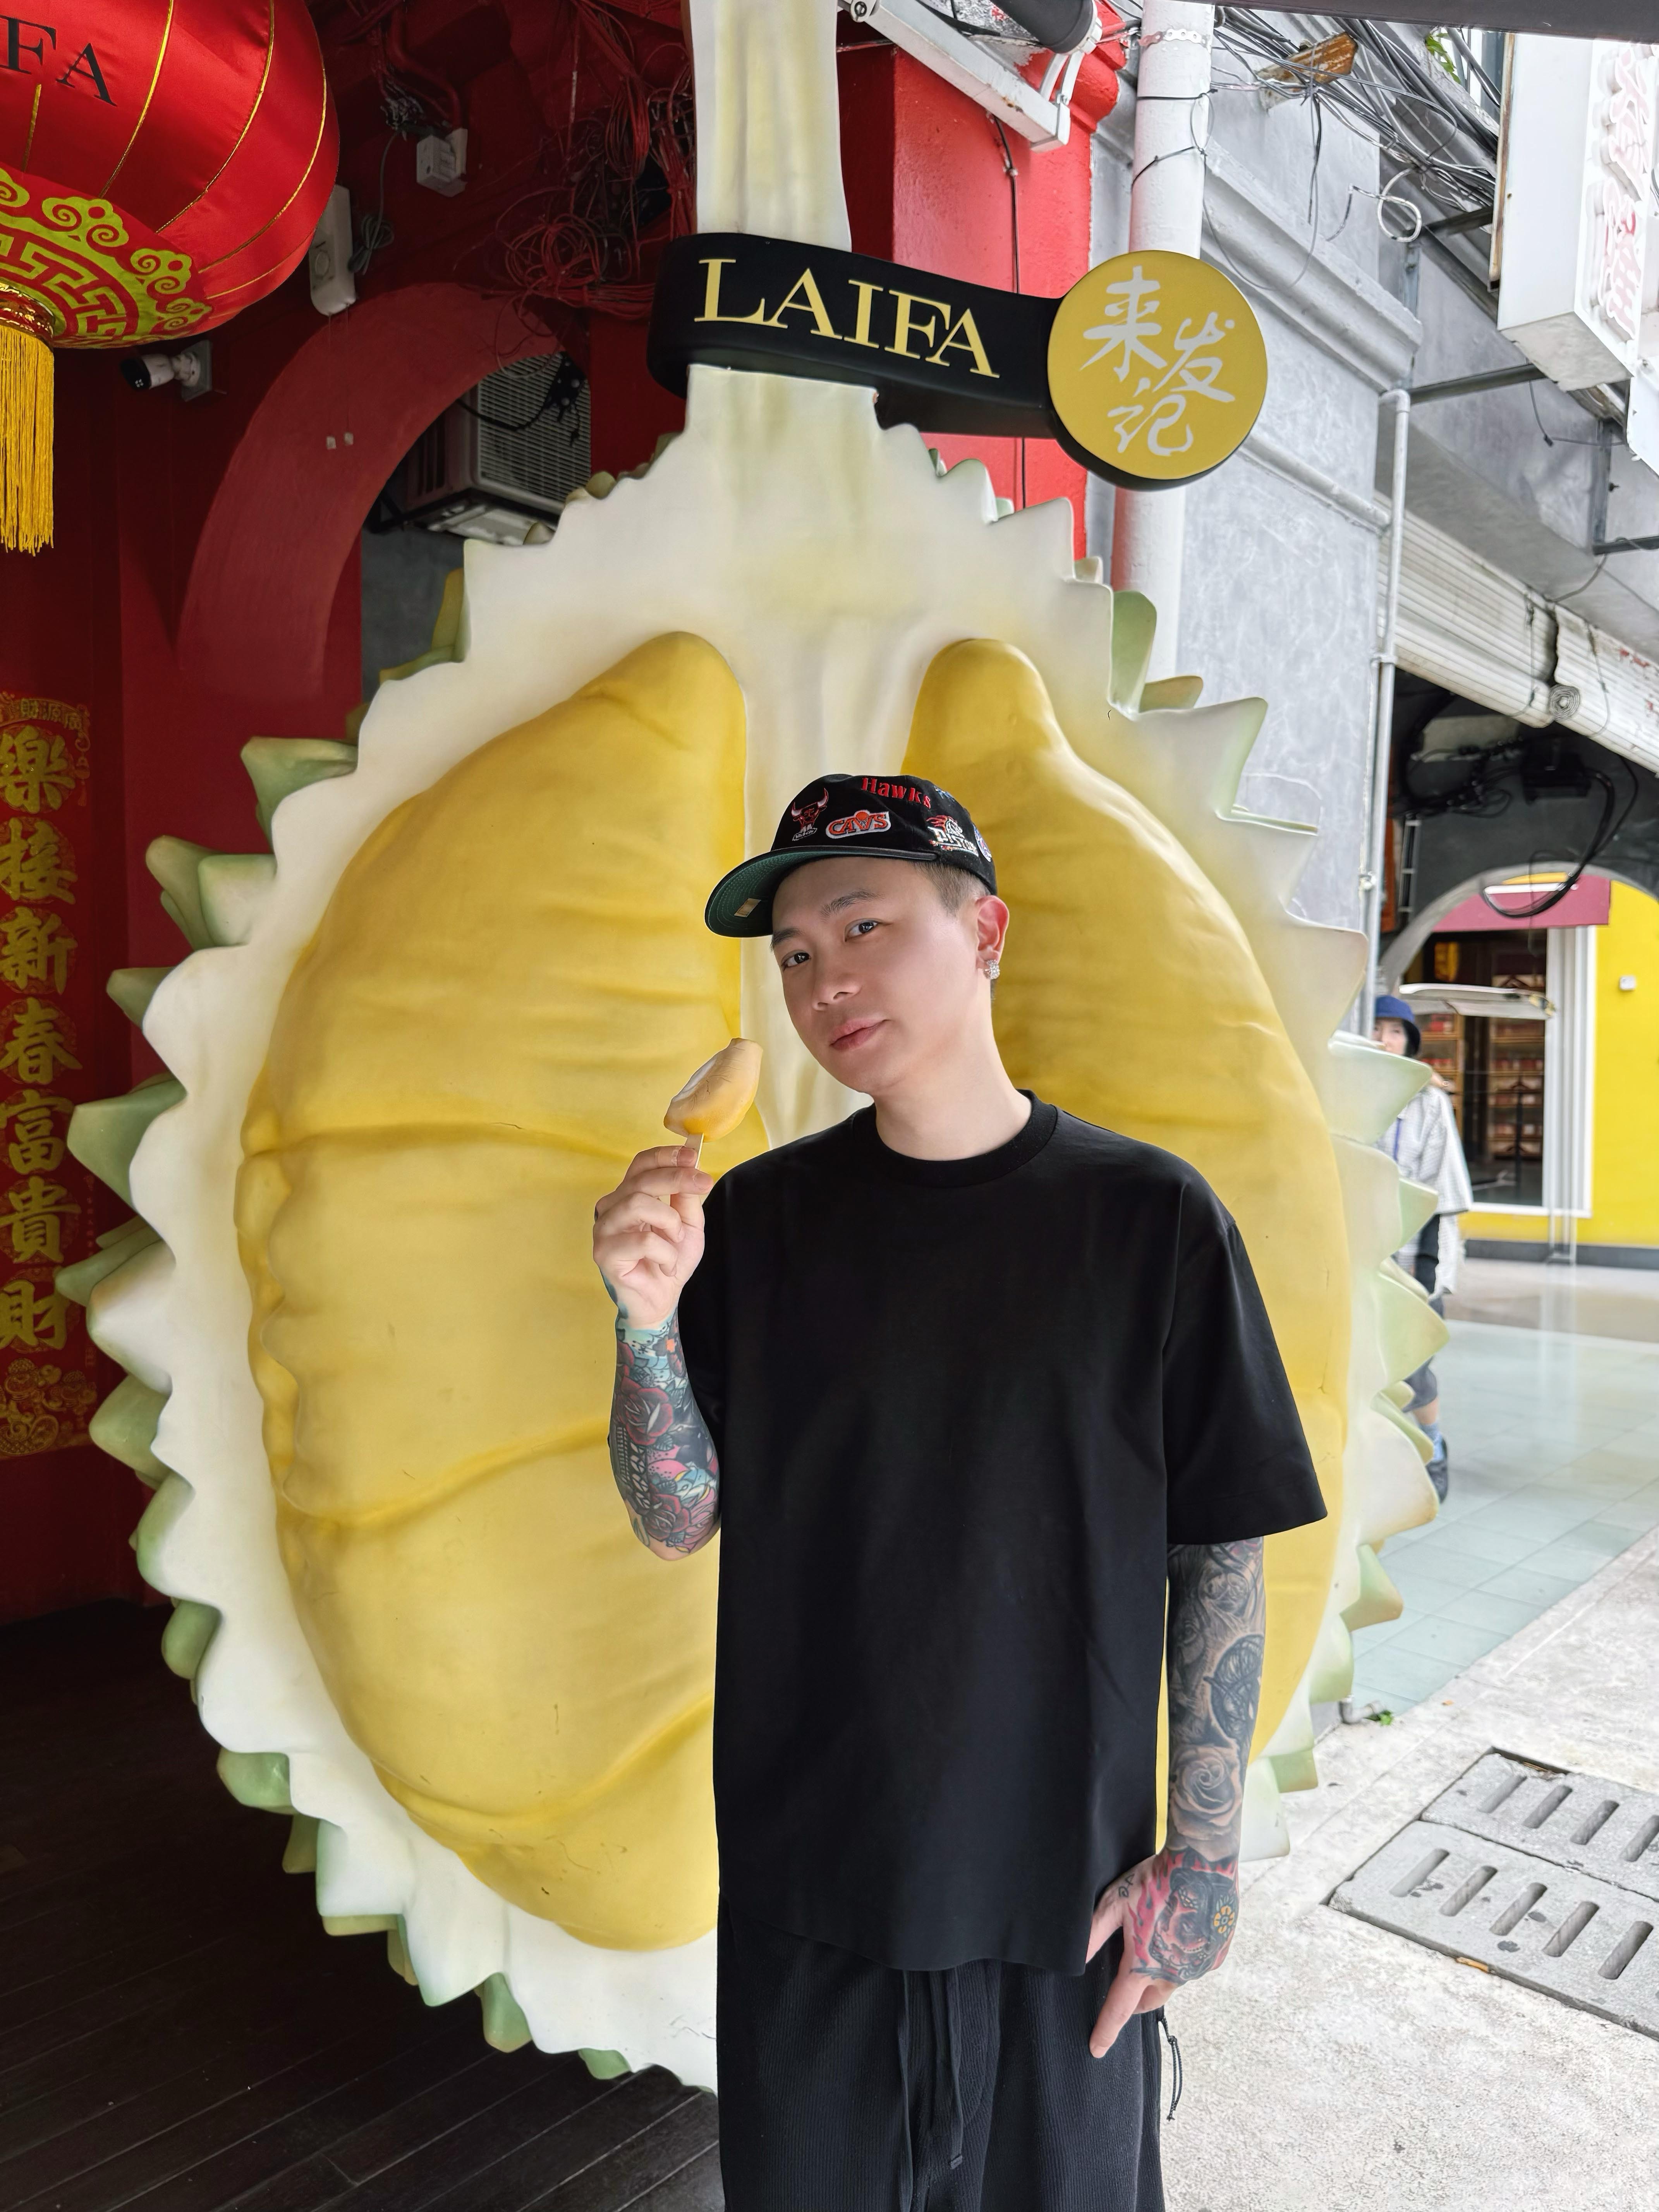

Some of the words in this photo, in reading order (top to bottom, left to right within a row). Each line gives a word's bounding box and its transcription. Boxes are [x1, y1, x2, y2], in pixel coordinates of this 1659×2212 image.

[694, 258, 1000, 378] LAIFA
[861, 777, 931, 809] Hawks
[828, 811, 888, 835] CAVS
